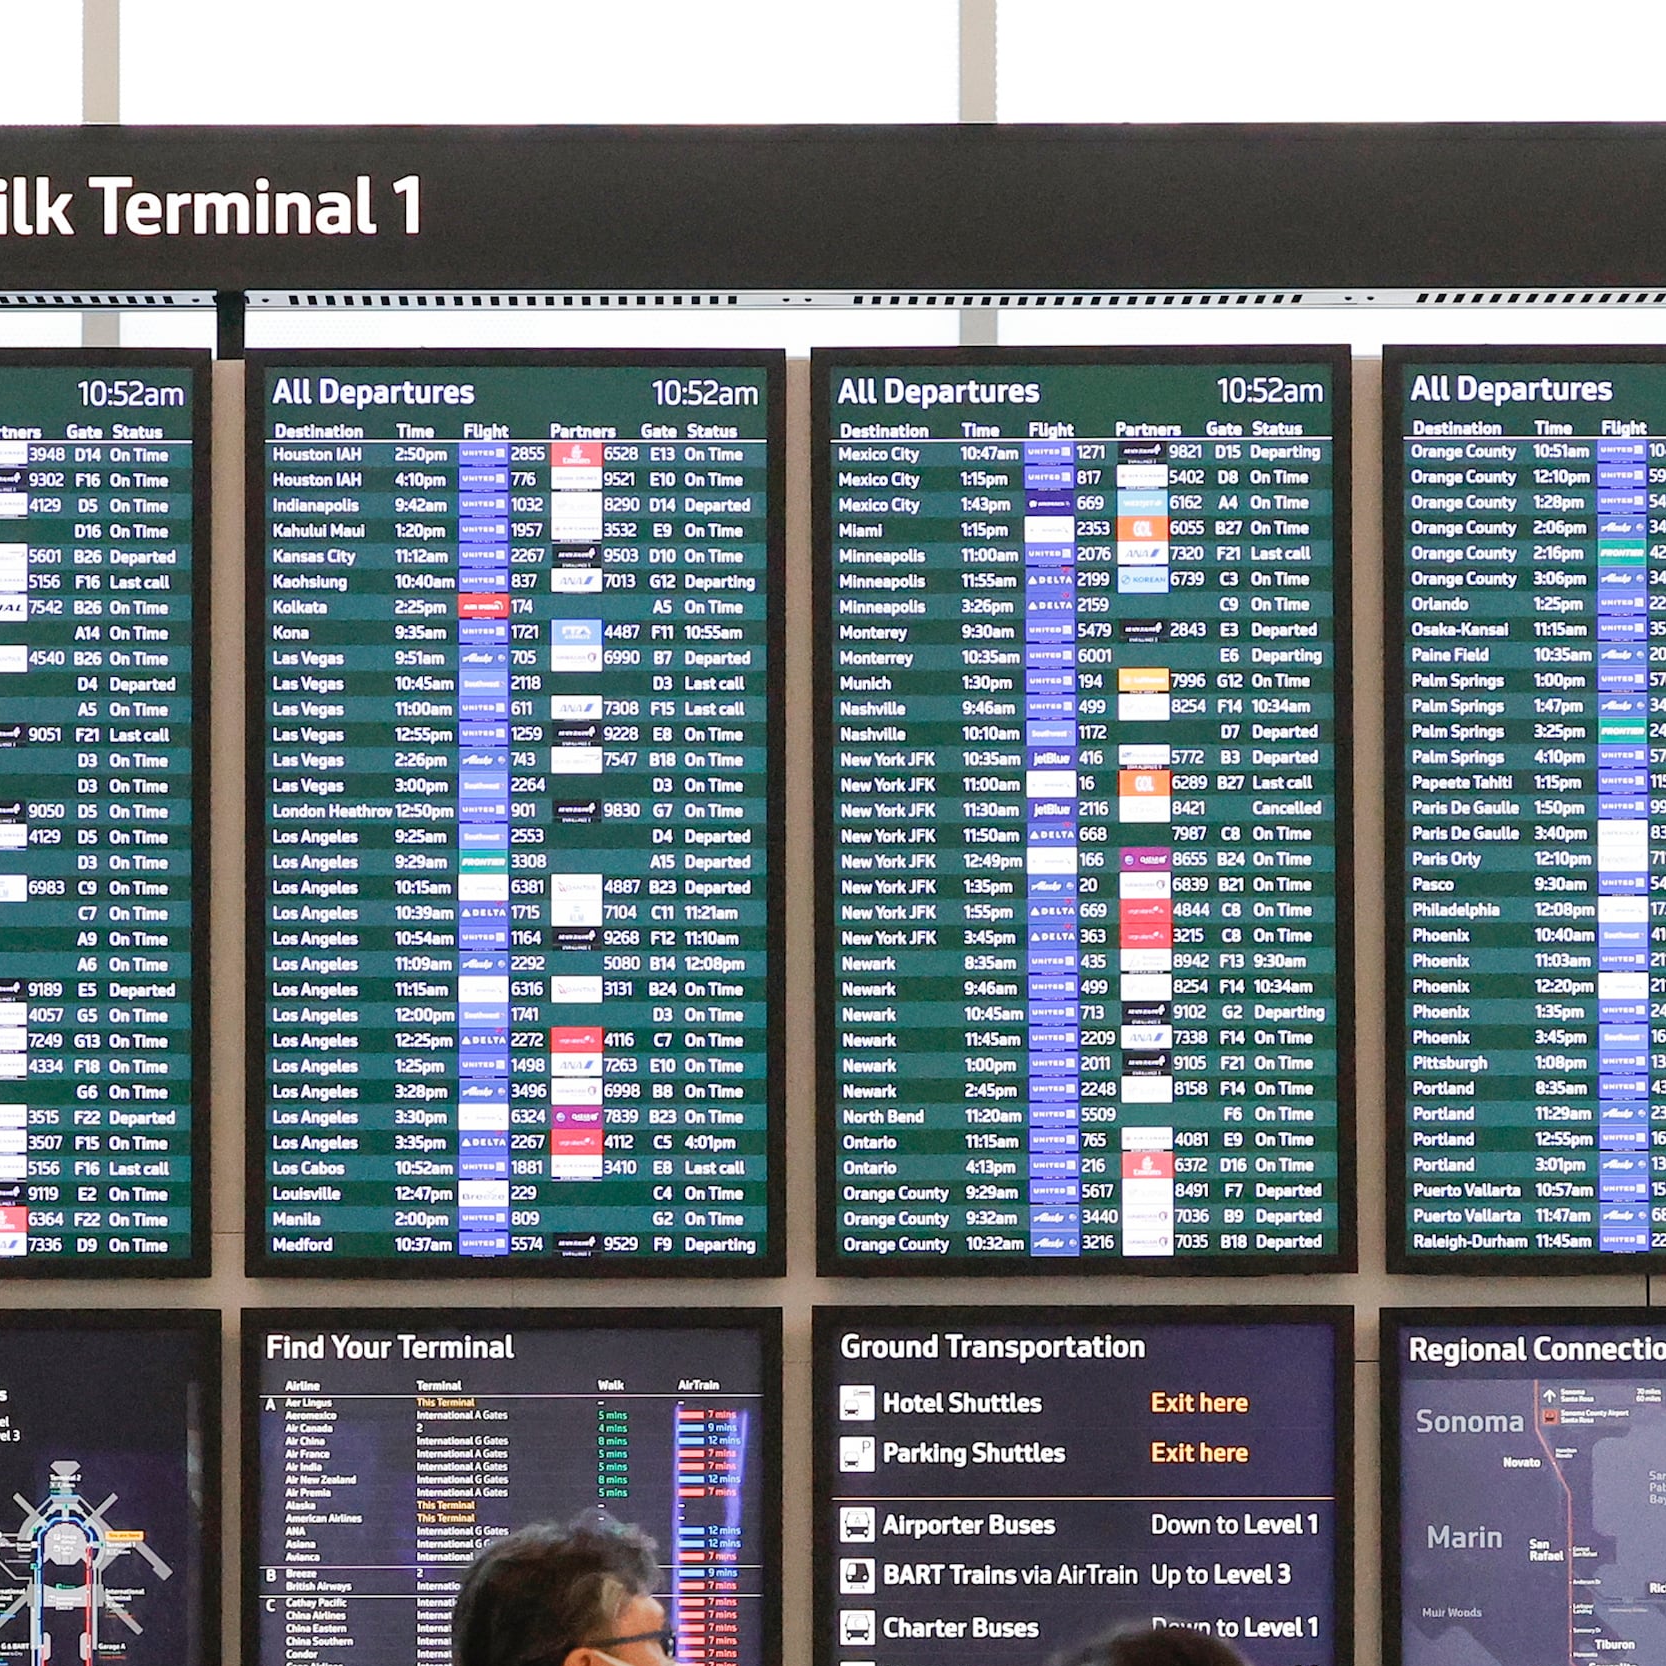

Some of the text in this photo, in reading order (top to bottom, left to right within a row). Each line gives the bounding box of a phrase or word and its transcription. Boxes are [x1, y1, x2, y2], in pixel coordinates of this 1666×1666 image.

[88, 175, 377, 236] Terminal
[392, 175, 419, 234] 1
[272, 378, 475, 410] All Departures
[652, 379, 759, 406] 10:52am
[1410, 375, 1613, 407] All Departures
[839, 596, 1310, 617] Minneapolis 3:26pm DELTA 2159 C9 On Time
[267, 1334, 515, 1360] Find Your Terminal
[840, 1333, 1146, 1364] Ground Transportation
[1409, 1336, 1528, 1368] Regional
[883, 1391, 1249, 1414] Hotel Shuttles Exit here
[1416, 1408, 1524, 1433] Sonoma
[882, 1513, 1318, 1540] Airporter Buses Down to Level 1
[1427, 1524, 1503, 1549] Marin
[883, 1562, 1292, 1589] BART Trains via AirTrain Up to Level 3
